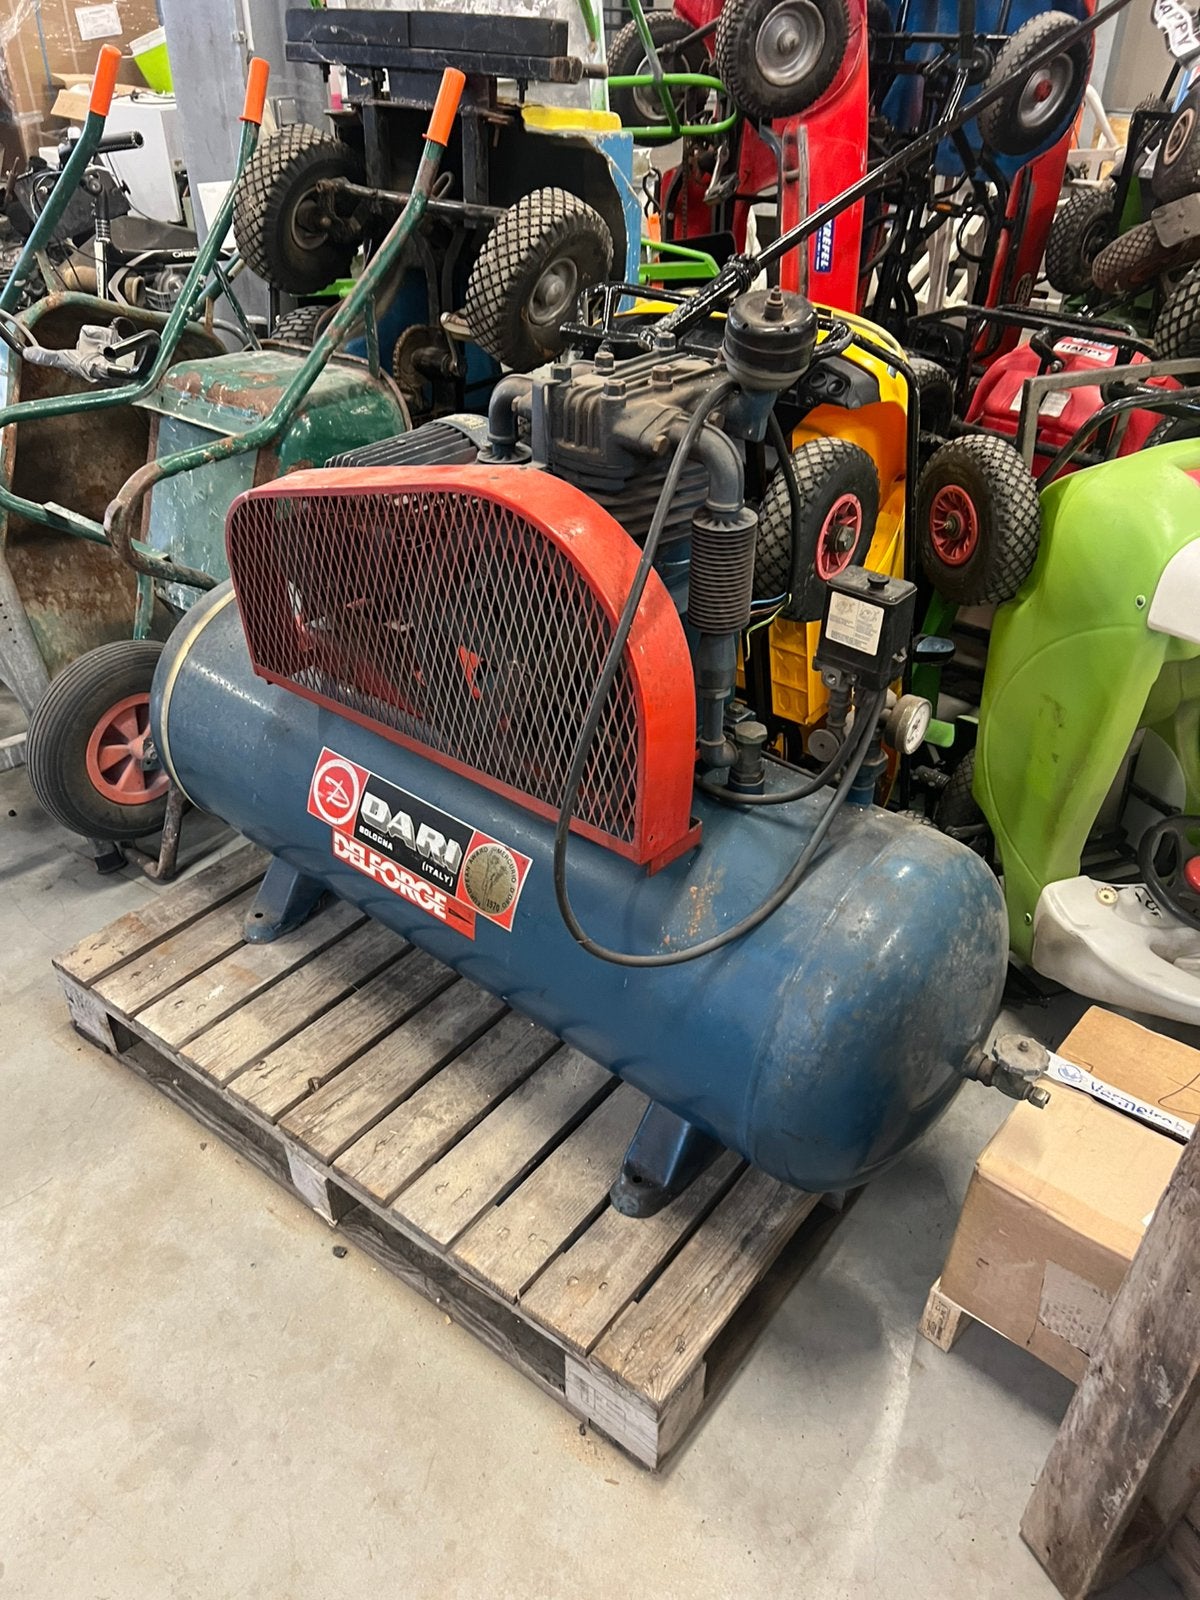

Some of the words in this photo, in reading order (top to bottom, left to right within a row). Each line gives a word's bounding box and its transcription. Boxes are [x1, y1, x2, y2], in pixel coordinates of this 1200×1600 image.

[358, 825, 393, 851] BOLOGNA
[360, 791, 463, 875] DARI
[333, 830, 448, 920] DELFORGE
[421, 861, 454, 887] (ITALY)
